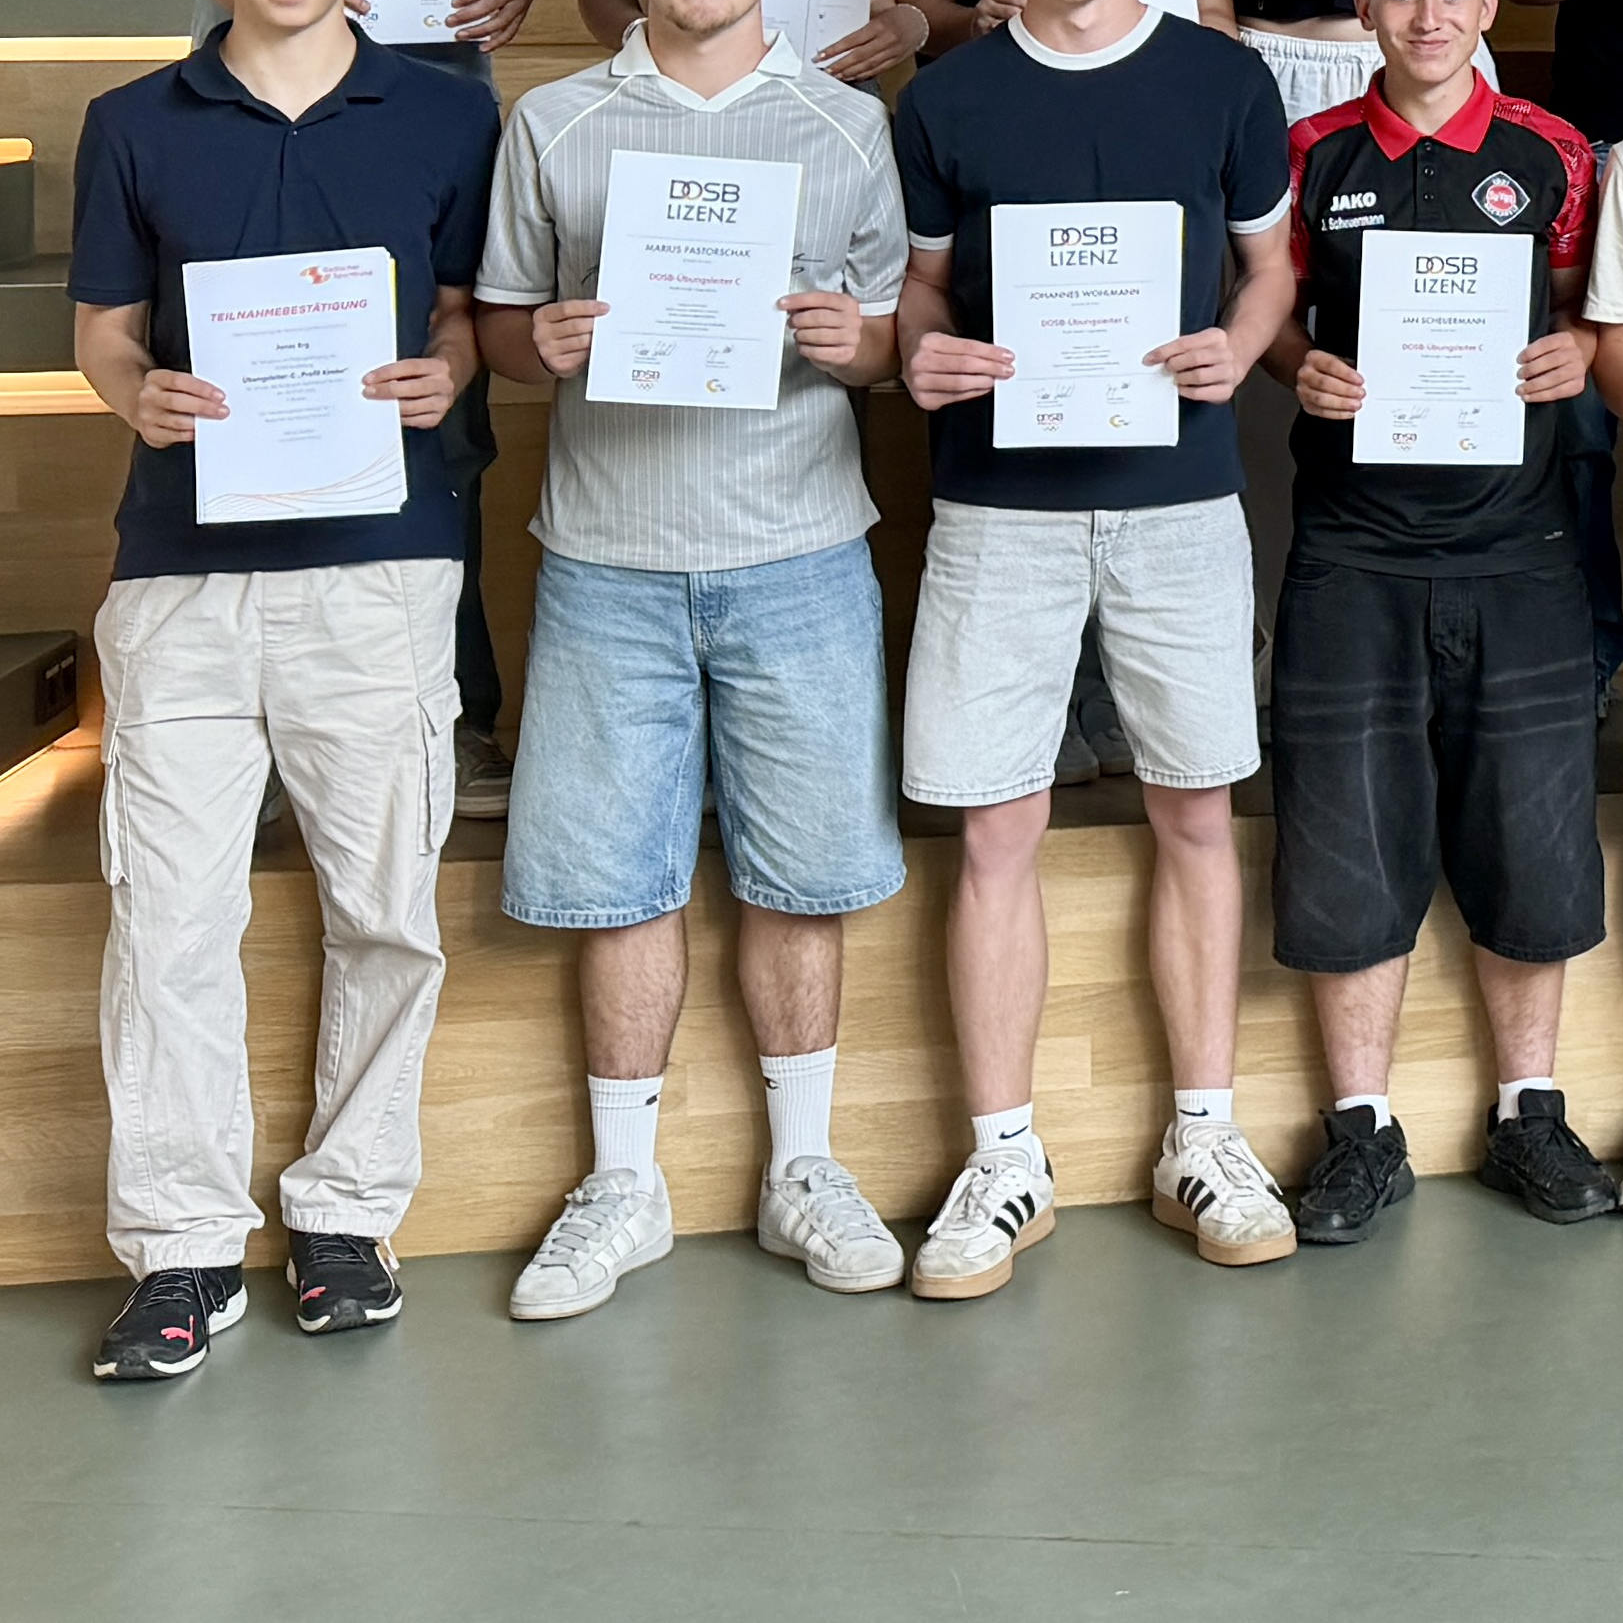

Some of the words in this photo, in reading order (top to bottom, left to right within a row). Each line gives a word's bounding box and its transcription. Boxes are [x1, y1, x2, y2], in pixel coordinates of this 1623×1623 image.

[669, 179, 741, 203] DOSB
[1330, 191, 1377, 212] JAKO
[666, 204, 738, 224] LIZENZ
[1050, 226, 1119, 247] DOSB
[645, 244, 683, 255] MARIUS
[1050, 249, 1119, 267] LIZENZ
[1415, 256, 1478, 275] DOSB
[1414, 278, 1477, 295] LIZENZ
[209, 298, 369, 323] TEILNAHMEBESTÄTIGUNG
